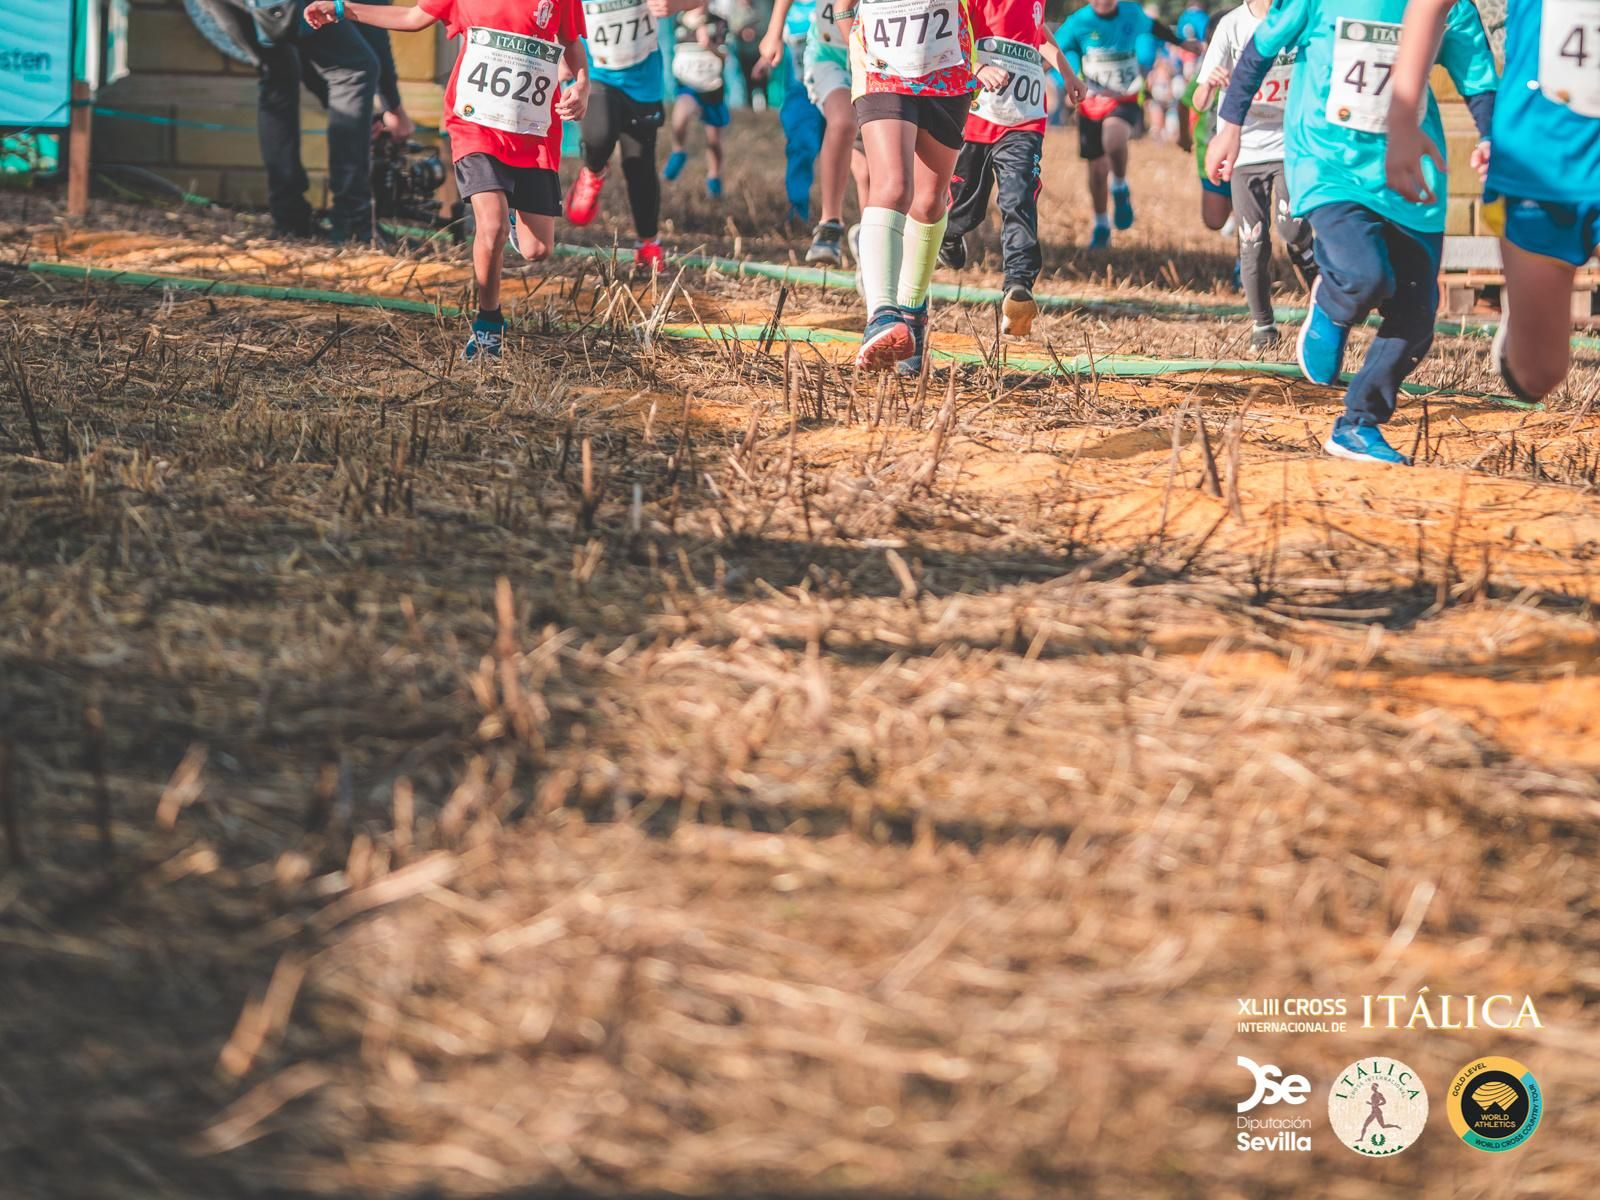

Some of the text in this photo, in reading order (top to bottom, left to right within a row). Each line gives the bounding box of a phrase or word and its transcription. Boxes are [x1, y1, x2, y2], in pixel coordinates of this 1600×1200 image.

[594, 13, 654, 46] 4771
[873, 8, 953, 48] 4772
[467, 62, 551, 107] 4628
[984, 71, 1041, 106] 700
